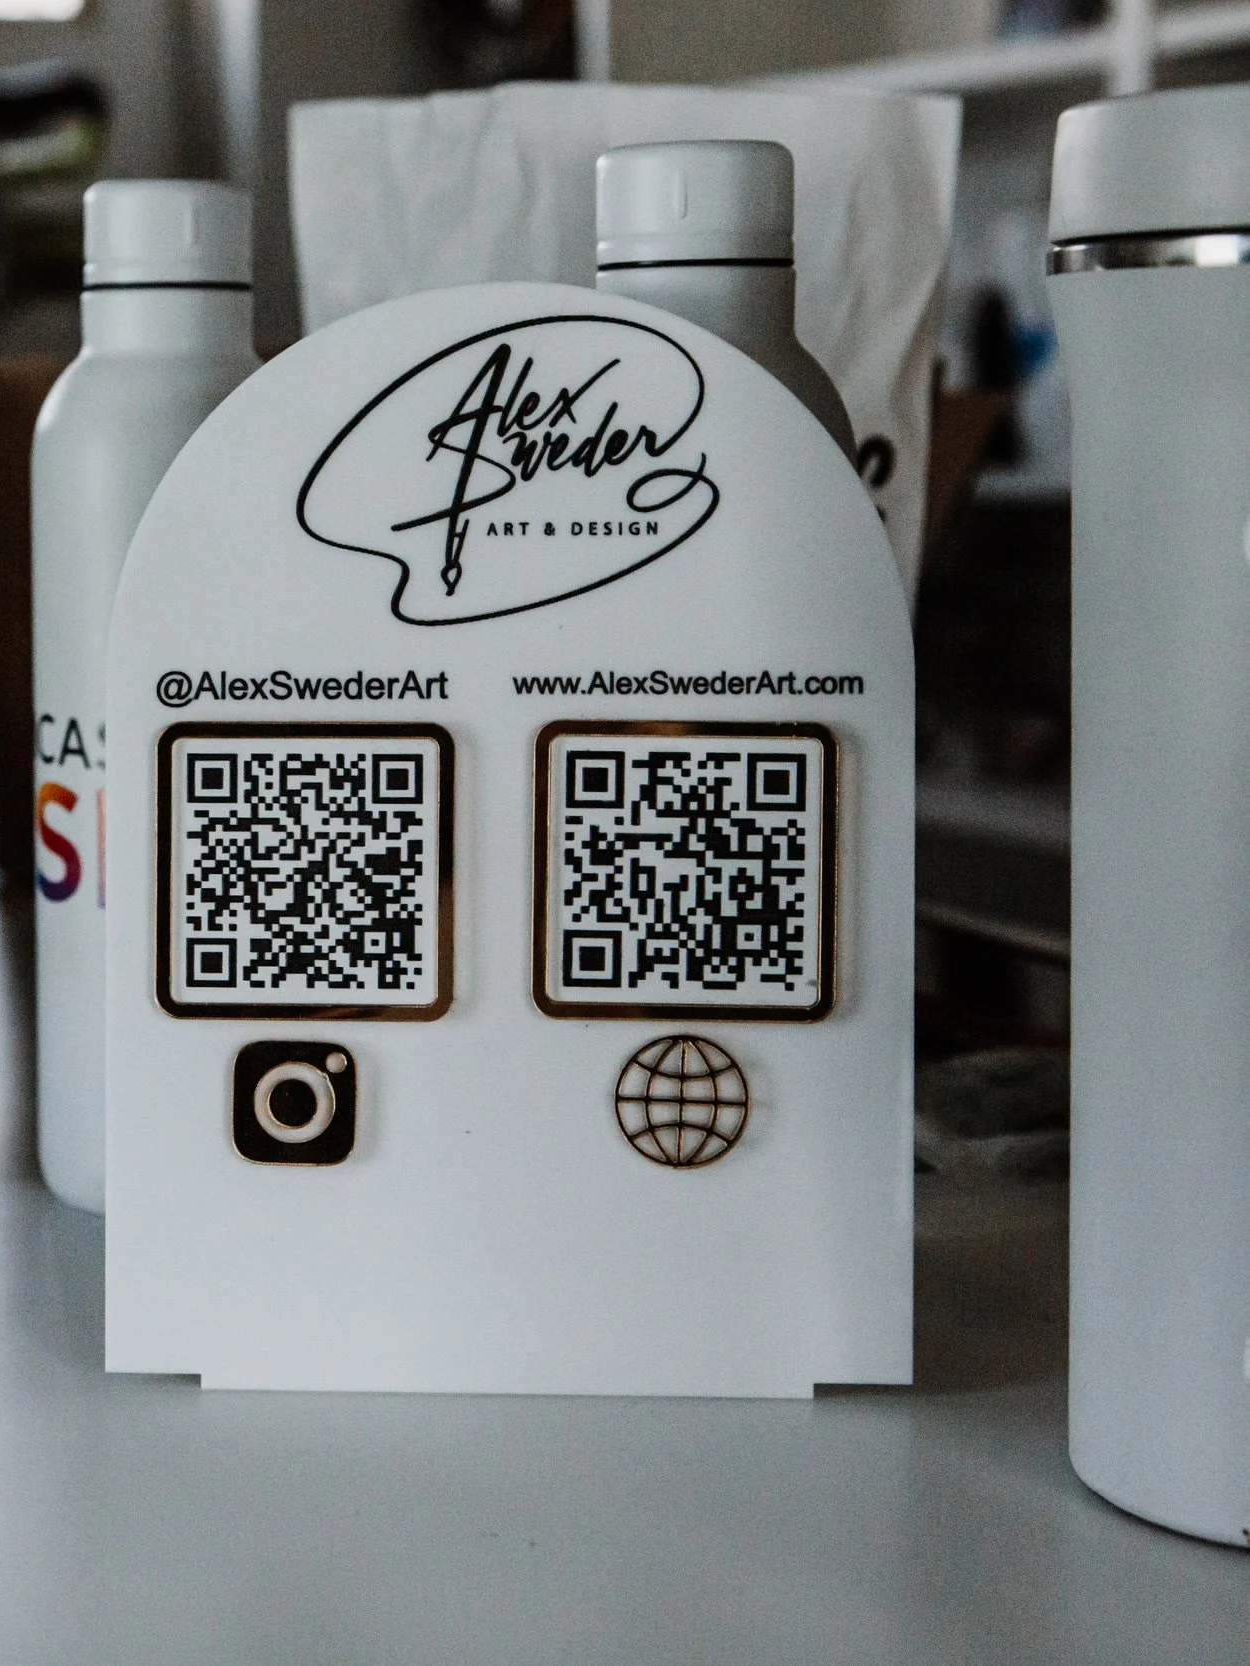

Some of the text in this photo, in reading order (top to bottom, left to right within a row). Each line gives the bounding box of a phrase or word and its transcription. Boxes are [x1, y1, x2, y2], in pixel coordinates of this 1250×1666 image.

[426, 342, 622, 462] Alex
[390, 401, 668, 533] Sweder
[486, 520, 660, 537] ART & DESIGN
[156, 669, 449, 709] @AlexSwederArt
[512, 669, 866, 696] www.AlexSwederArt.com
[36, 780, 106, 909] S
